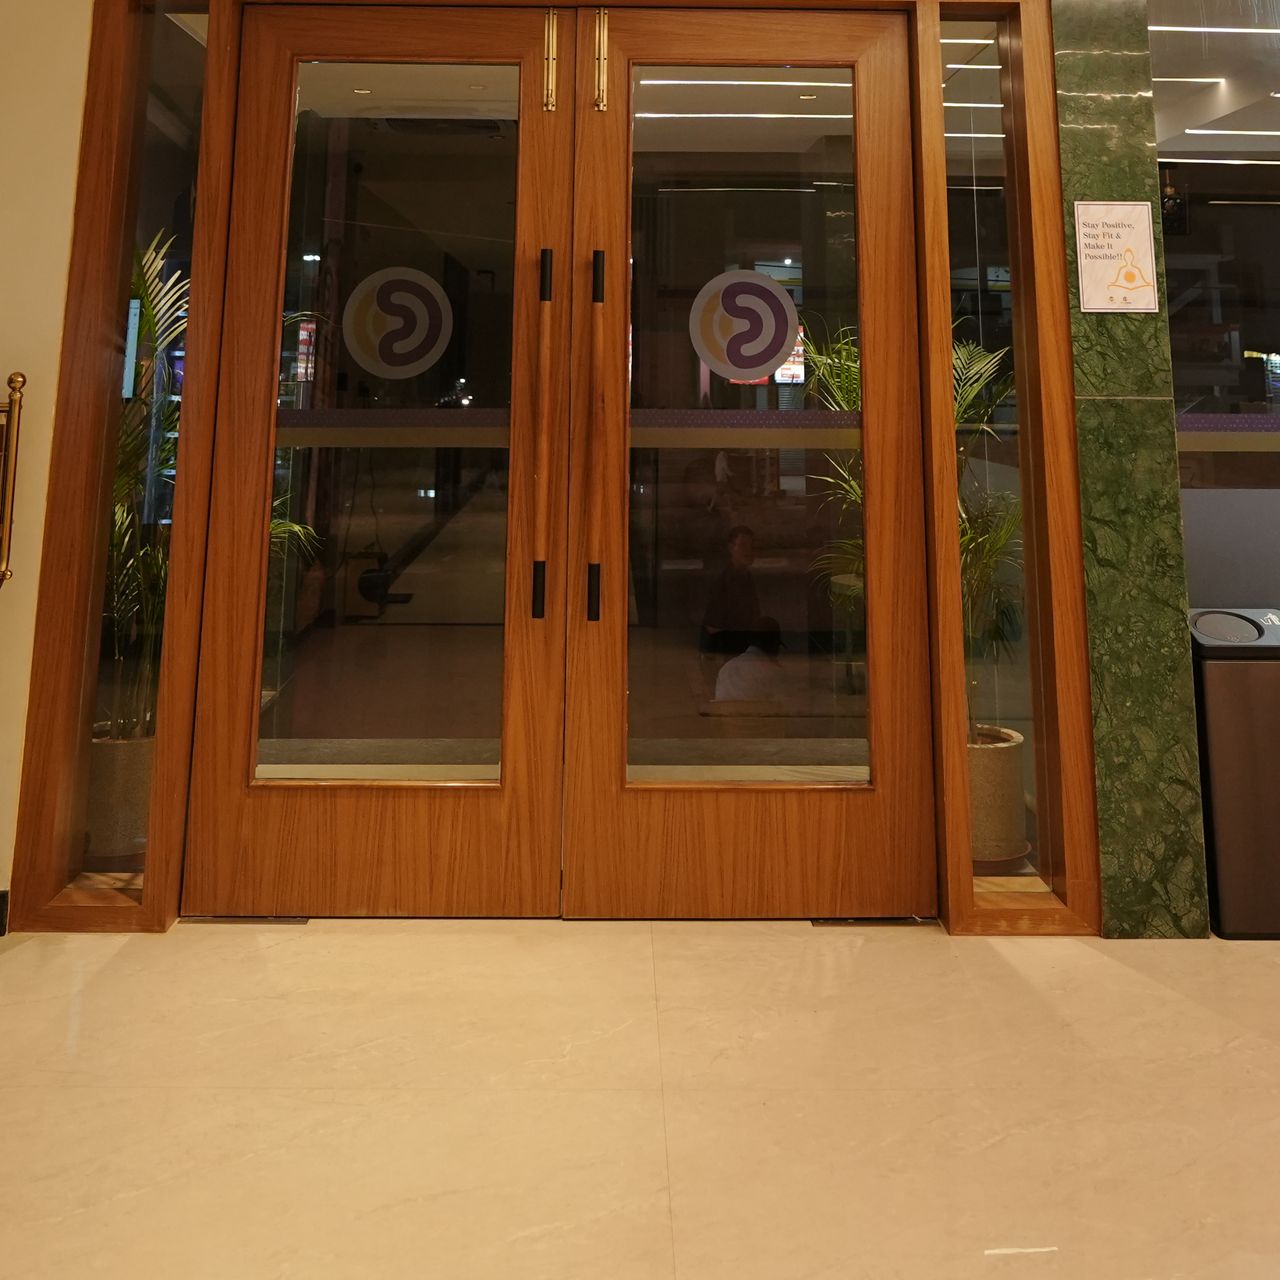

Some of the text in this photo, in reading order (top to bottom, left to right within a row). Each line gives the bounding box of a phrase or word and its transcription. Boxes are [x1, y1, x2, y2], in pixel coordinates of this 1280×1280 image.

[1082, 221, 1135, 230] Stay Positive,
[1083, 232, 1101, 240] Stay
[1084, 242, 1105, 250] Make
[1085, 253, 1123, 261] Possible!!
